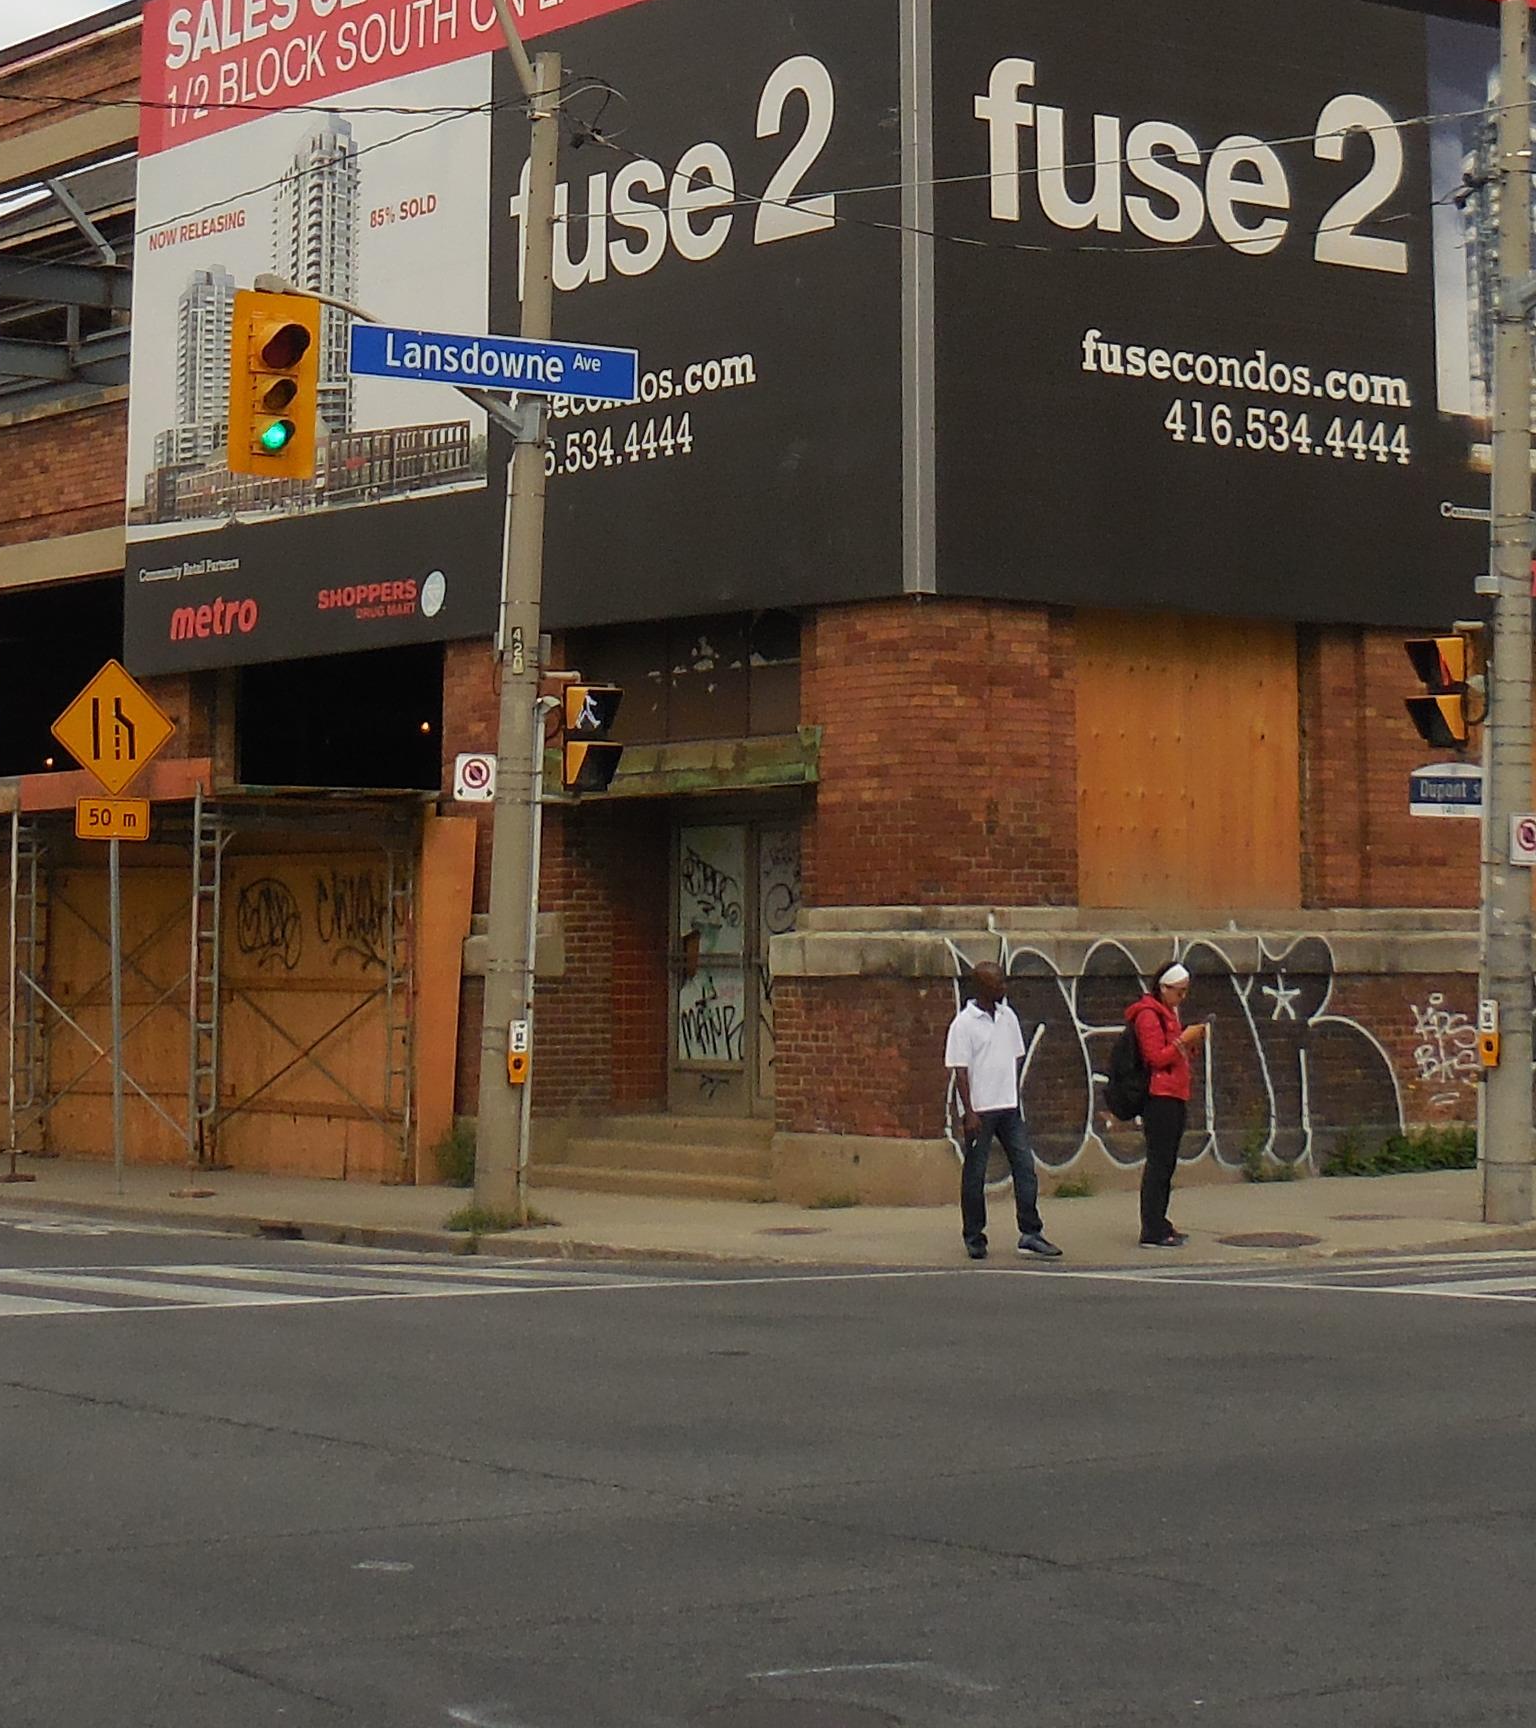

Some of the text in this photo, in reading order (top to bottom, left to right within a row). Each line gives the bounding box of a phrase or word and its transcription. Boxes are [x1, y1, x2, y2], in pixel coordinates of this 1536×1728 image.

[167, 74, 209, 128] 1/2
[218, 30, 326, 110] BLOCK
[754, 54, 836, 245] 2
[974, 57, 1408, 273] fuse 2
[148, 209, 246, 252] NOW RELEASING
[370, 193, 437, 229] 85% SOLD
[385, 332, 602, 383] Lansdowne Ave
[1081, 327, 1412, 408] fusecondos.com
[544, 411, 694, 478] 6.534.4444
[1164, 398, 1411, 465] 416.534.4444
[170, 595, 258, 641] metro
[317, 578, 418, 610] SHOPPERS
[1420, 779, 1467, 802] Dupont
[89, 808, 137, 827] 50 m
